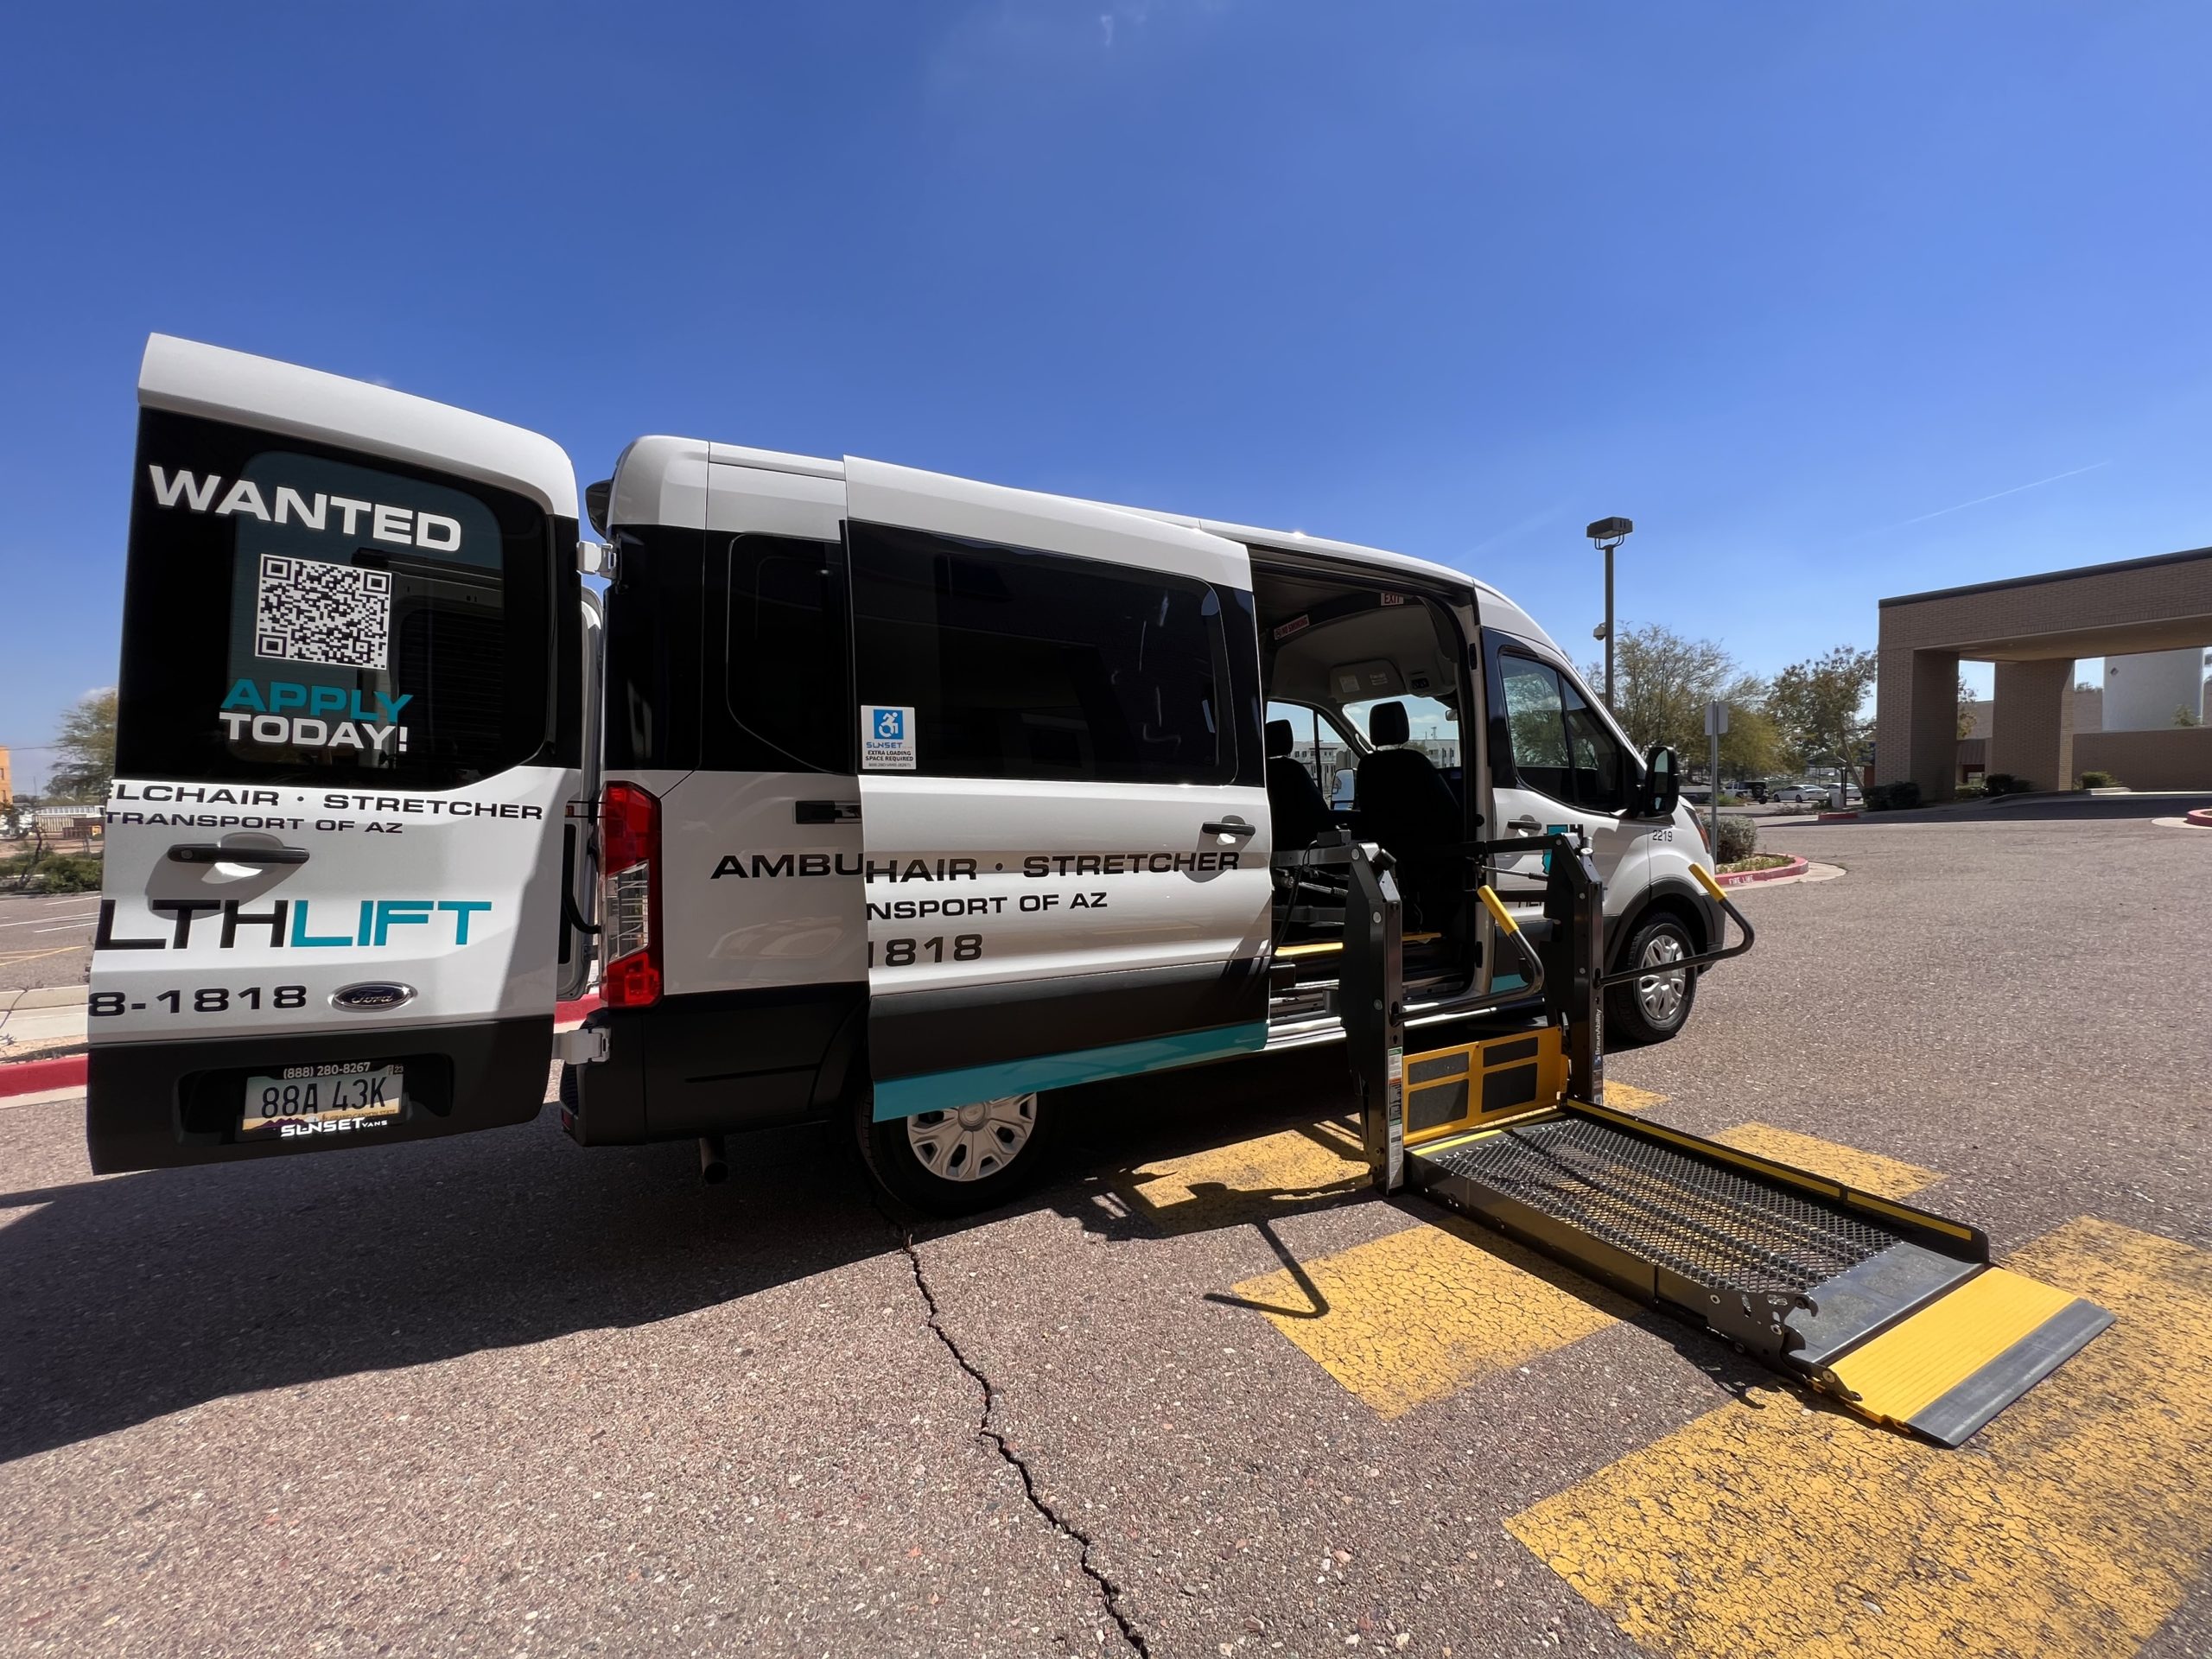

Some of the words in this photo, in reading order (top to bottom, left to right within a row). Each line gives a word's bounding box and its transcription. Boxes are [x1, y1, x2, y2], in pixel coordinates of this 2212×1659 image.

[149, 465, 461, 551] WANTED
[1384, 594, 1401, 604] EXIT
[220, 678, 414, 723] APPLY
[219, 712, 408, 752] TODAY!
[109, 783, 279, 805] LCHAIR
[323, 794, 543, 819] STRETCHER
[105, 811, 304, 830] TRANSPORT
[315, 819, 355, 831] OF
[364, 822, 403, 834] AZ
[1652, 830, 1673, 842] 2219
[866, 858, 978, 884] HAIR
[1023, 852, 1240, 878] STRETCHER
[866, 896, 1007, 921] NSPORT
[1020, 894, 1059, 912] OF
[1070, 892, 1108, 909] AZ
[94, 899, 492, 950] LTHLIFT
[88, 985, 307, 1017] 8-1818
[351, 989, 394, 1004] Ford
[283, 1067, 314, 1079] (888)
[317, 1062, 371, 1077] 280-8267
[261, 1083, 318, 1119] 88A
[332, 1077, 387, 1111] 43K
[281, 1117, 365, 1137] SUNSET
